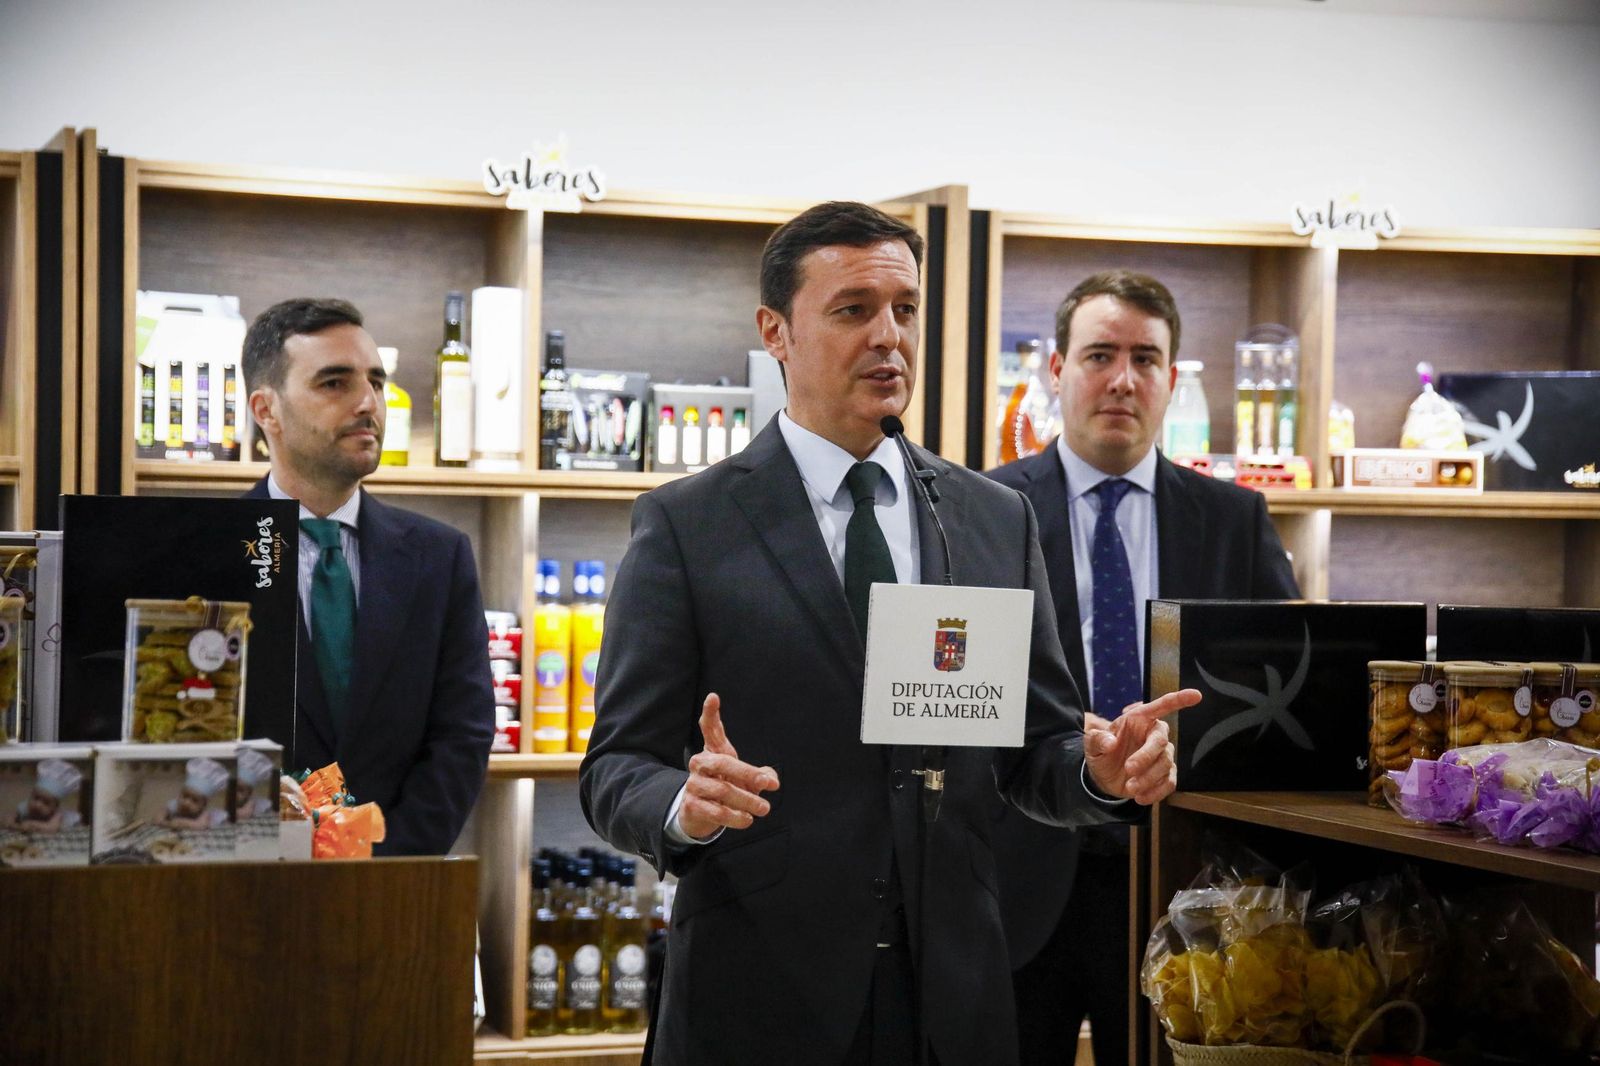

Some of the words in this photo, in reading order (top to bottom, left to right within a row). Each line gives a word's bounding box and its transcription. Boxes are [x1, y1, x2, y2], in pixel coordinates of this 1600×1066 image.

[485, 157, 602, 195] sabores
[250, 516, 274, 588] sabores
[891, 681, 1004, 700] DIPUTACIÓN
[893, 702, 916, 717] DE
[920, 701, 999, 719] ALMERÍA
